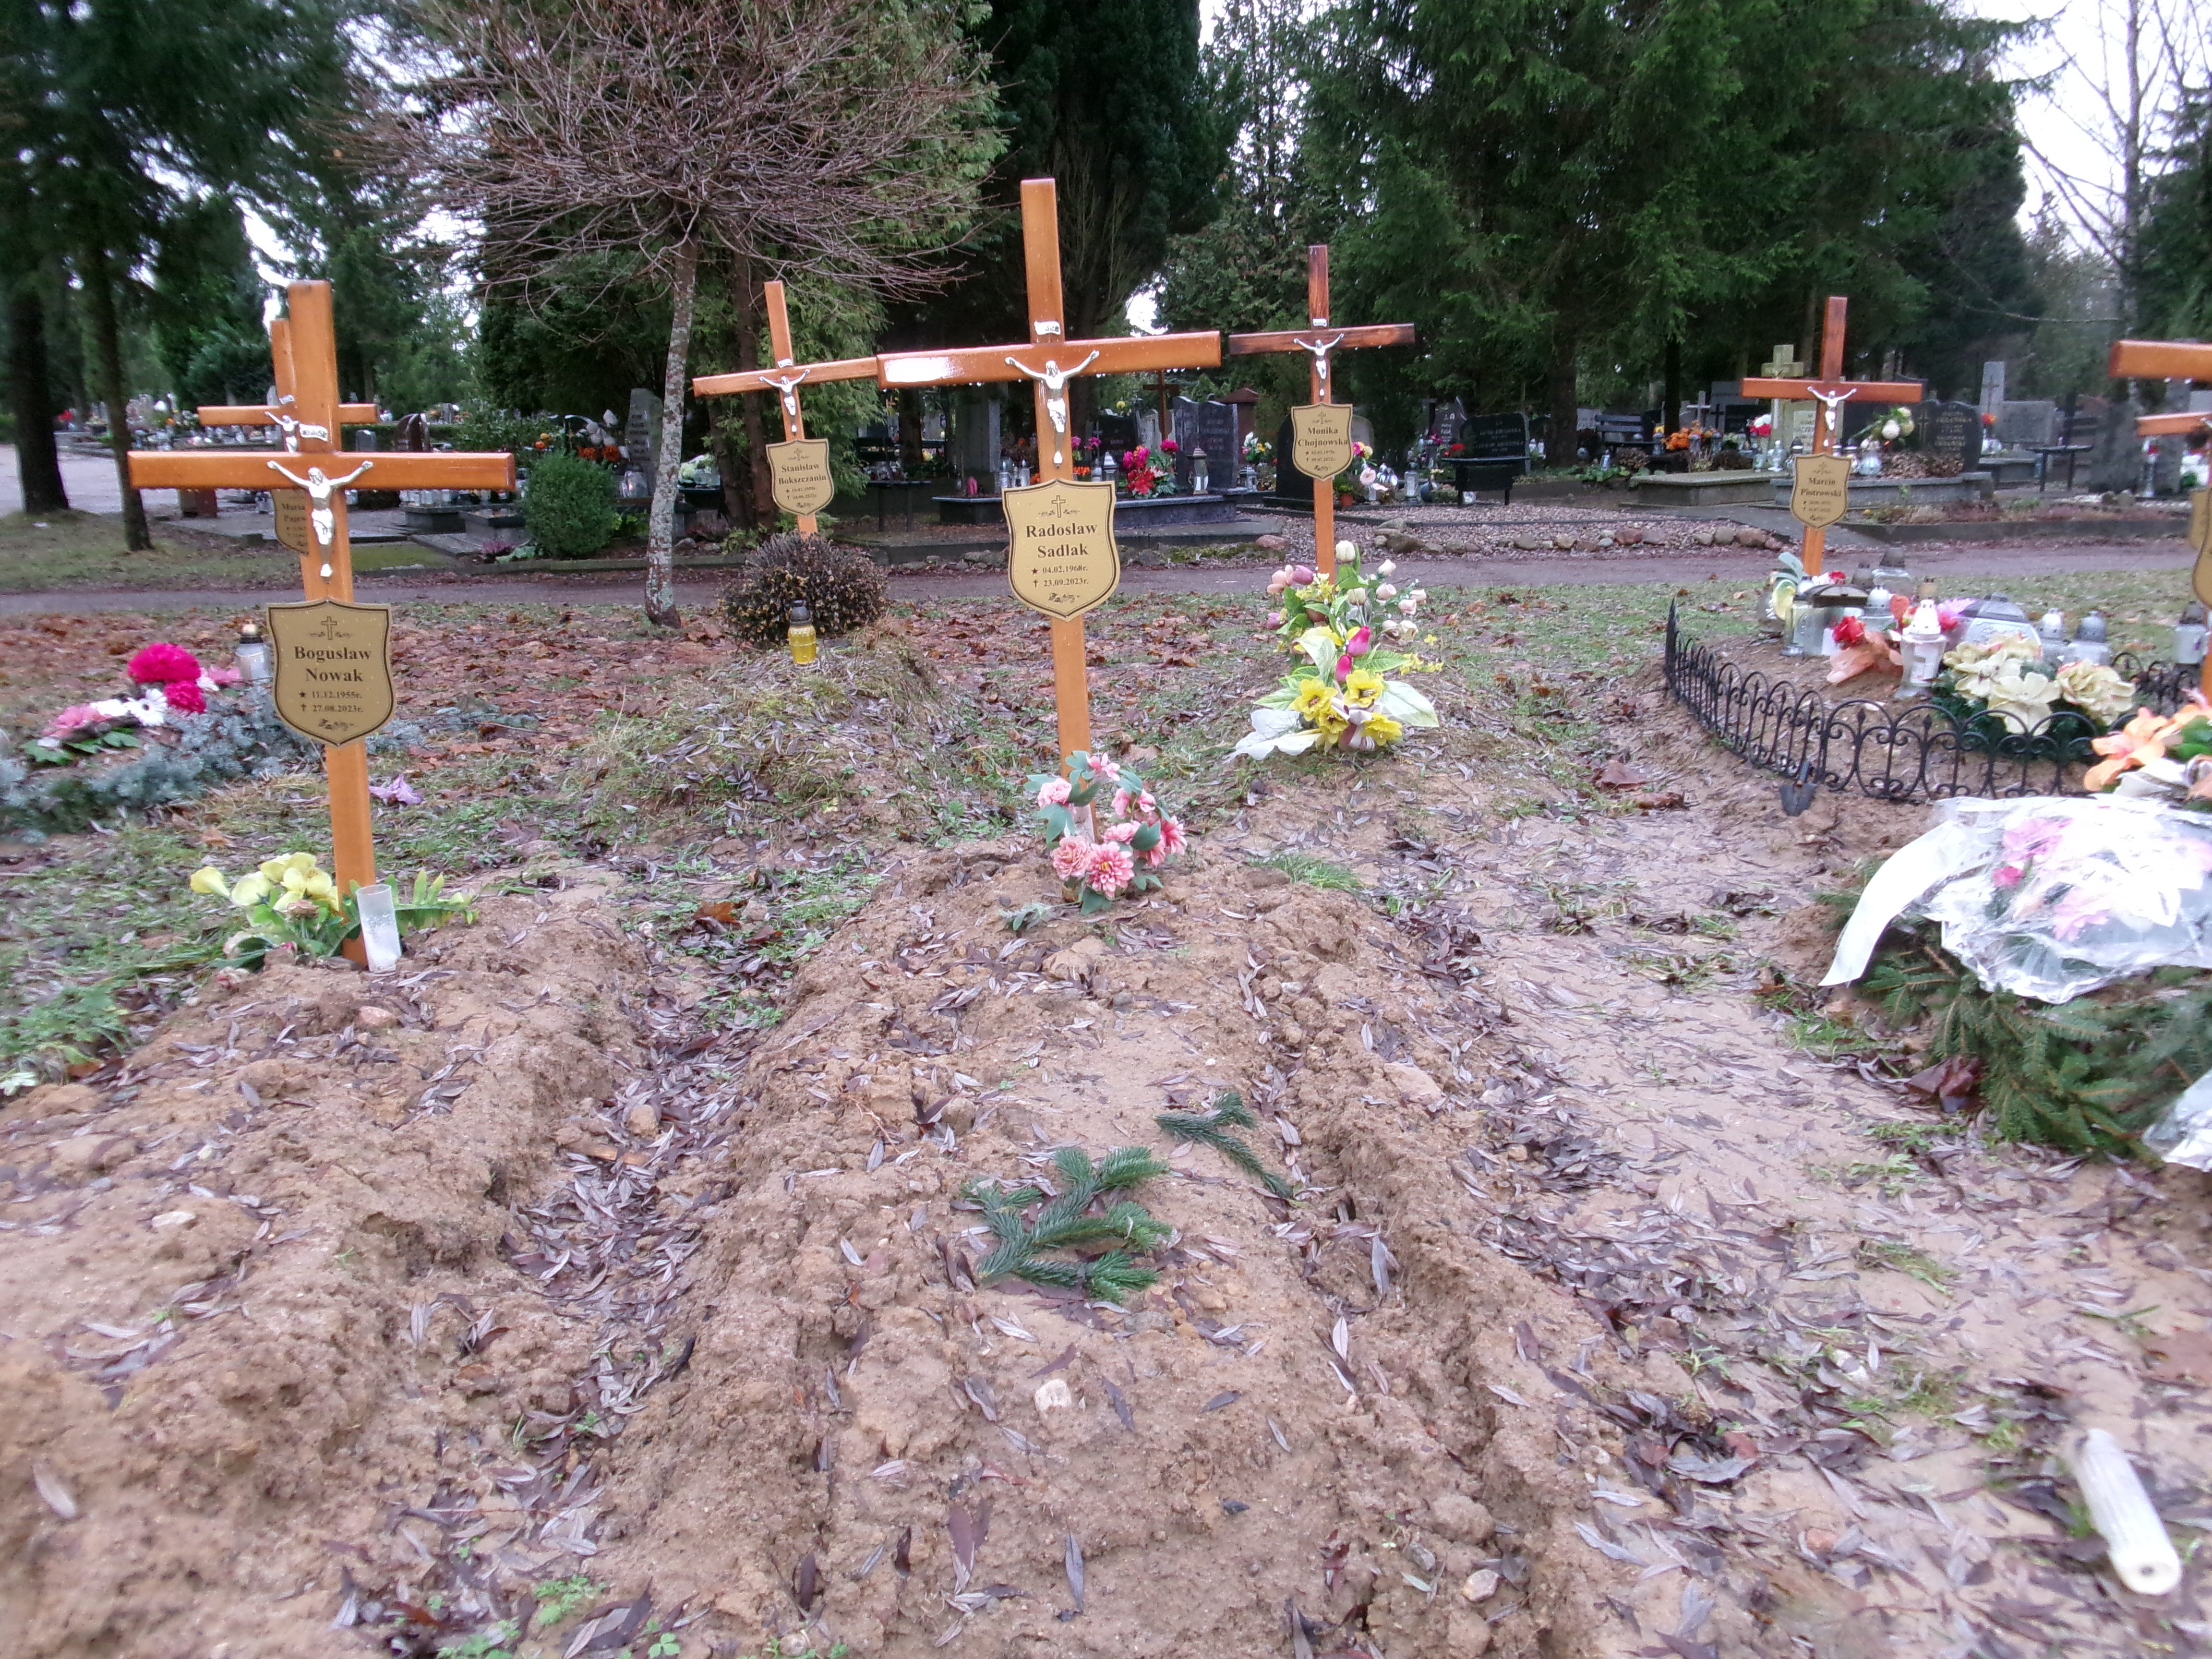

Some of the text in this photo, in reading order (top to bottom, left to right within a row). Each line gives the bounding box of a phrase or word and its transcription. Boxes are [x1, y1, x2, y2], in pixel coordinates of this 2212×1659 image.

[1298, 437, 1348, 447] Chojnowska
[1808, 477, 1836, 485] Marcin
[1801, 488, 1841, 497] Piotrowski
[1037, 543, 1089, 558] Sadlak
[1042, 565, 1088, 573] 04.02.1968r.
[1044, 577, 1089, 587] 23.09.2023r.
[305, 667, 363, 682] Nowak
